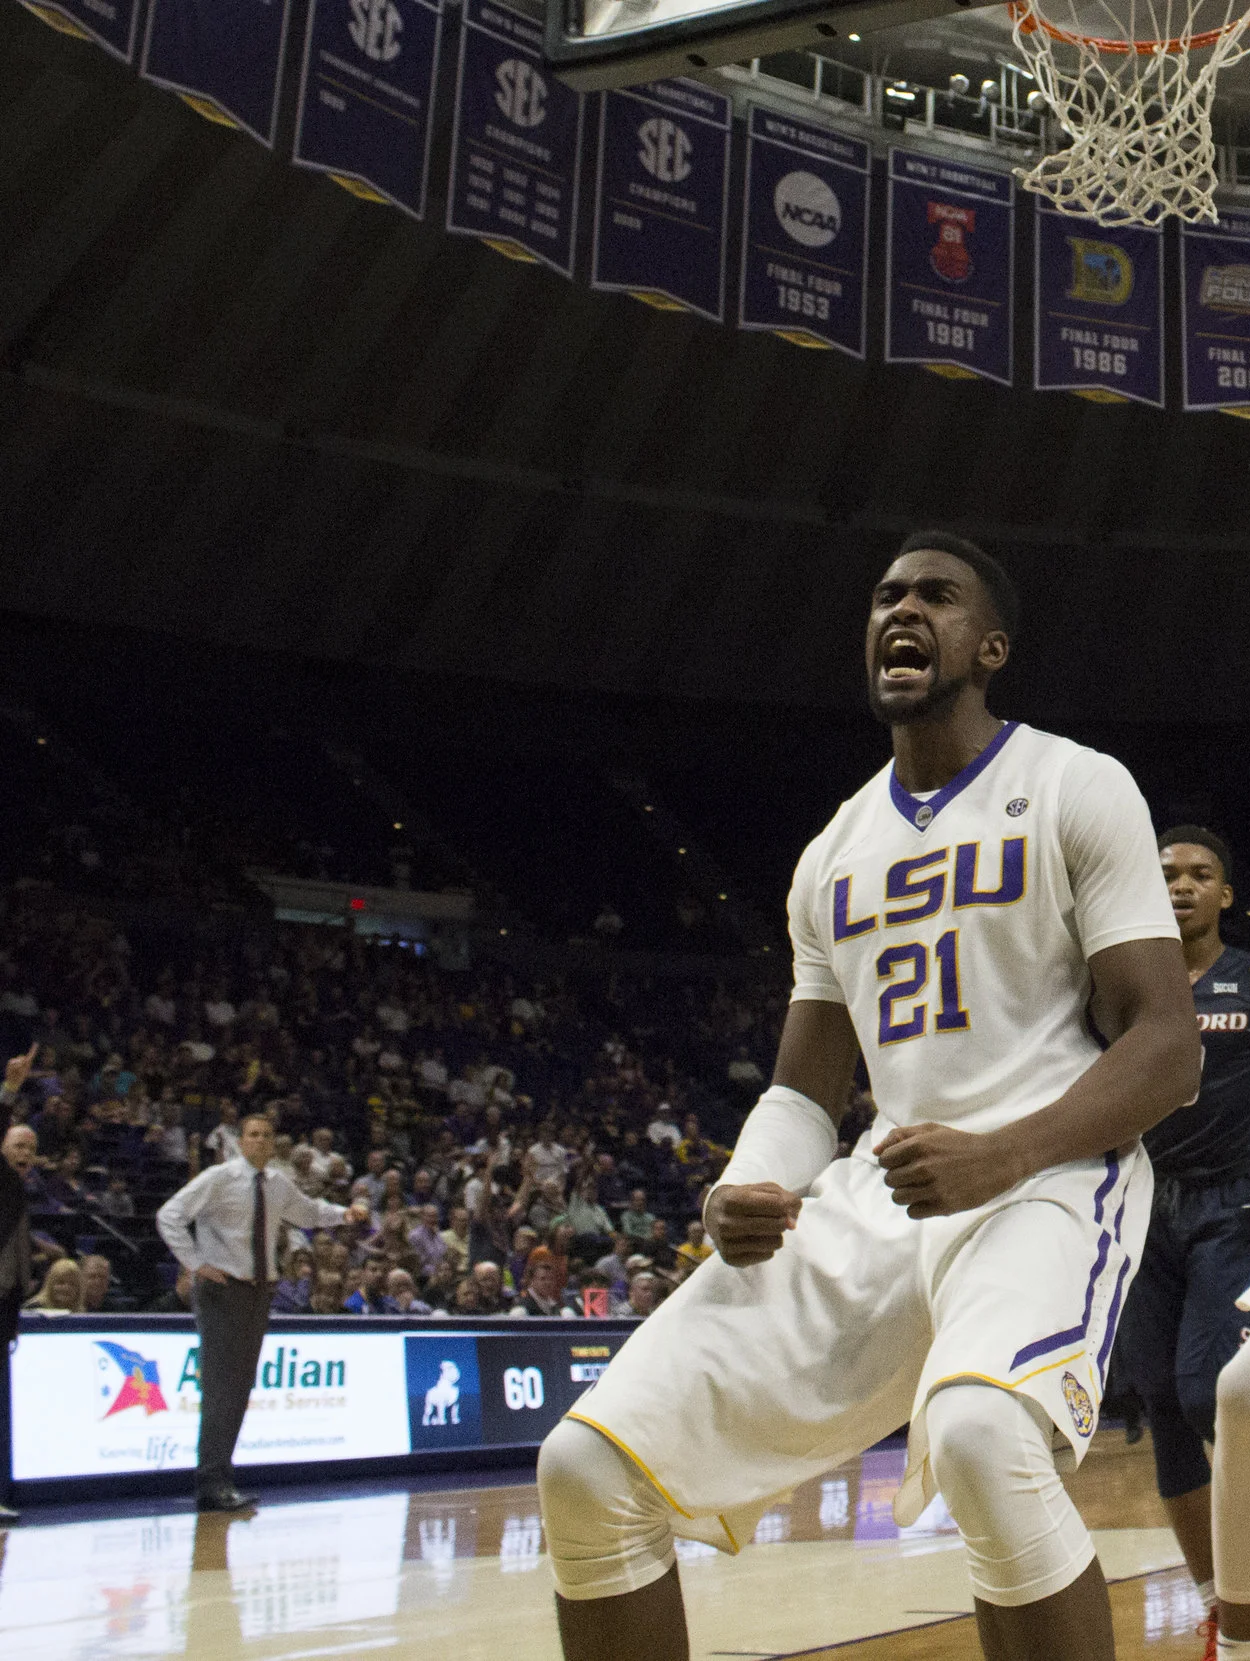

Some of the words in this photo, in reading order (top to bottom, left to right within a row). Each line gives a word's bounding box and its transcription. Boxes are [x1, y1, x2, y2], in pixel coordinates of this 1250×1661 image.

[495, 58, 549, 127] SEC
[638, 118, 693, 182] SEC
[781, 203, 838, 231] NCAA
[765, 262, 803, 286] FINAL
[806, 274, 843, 297] FOUR
[777, 284, 830, 320] 1953
[911, 298, 950, 321] FINAL
[952, 306, 989, 328] FOUR
[925, 321, 975, 351] 1981
[1060, 326, 1099, 347] FINAL
[1101, 333, 1140, 352] FOUR
[1072, 346, 1127, 377] 1986
[1207, 346, 1247, 364] FINAL
[1006, 798, 1029, 817] SEC
[833, 836, 1028, 945] LSU
[876, 928, 970, 1048] 21
[177, 1347, 346, 1392] Adian
[503, 1366, 544, 1410] 60
